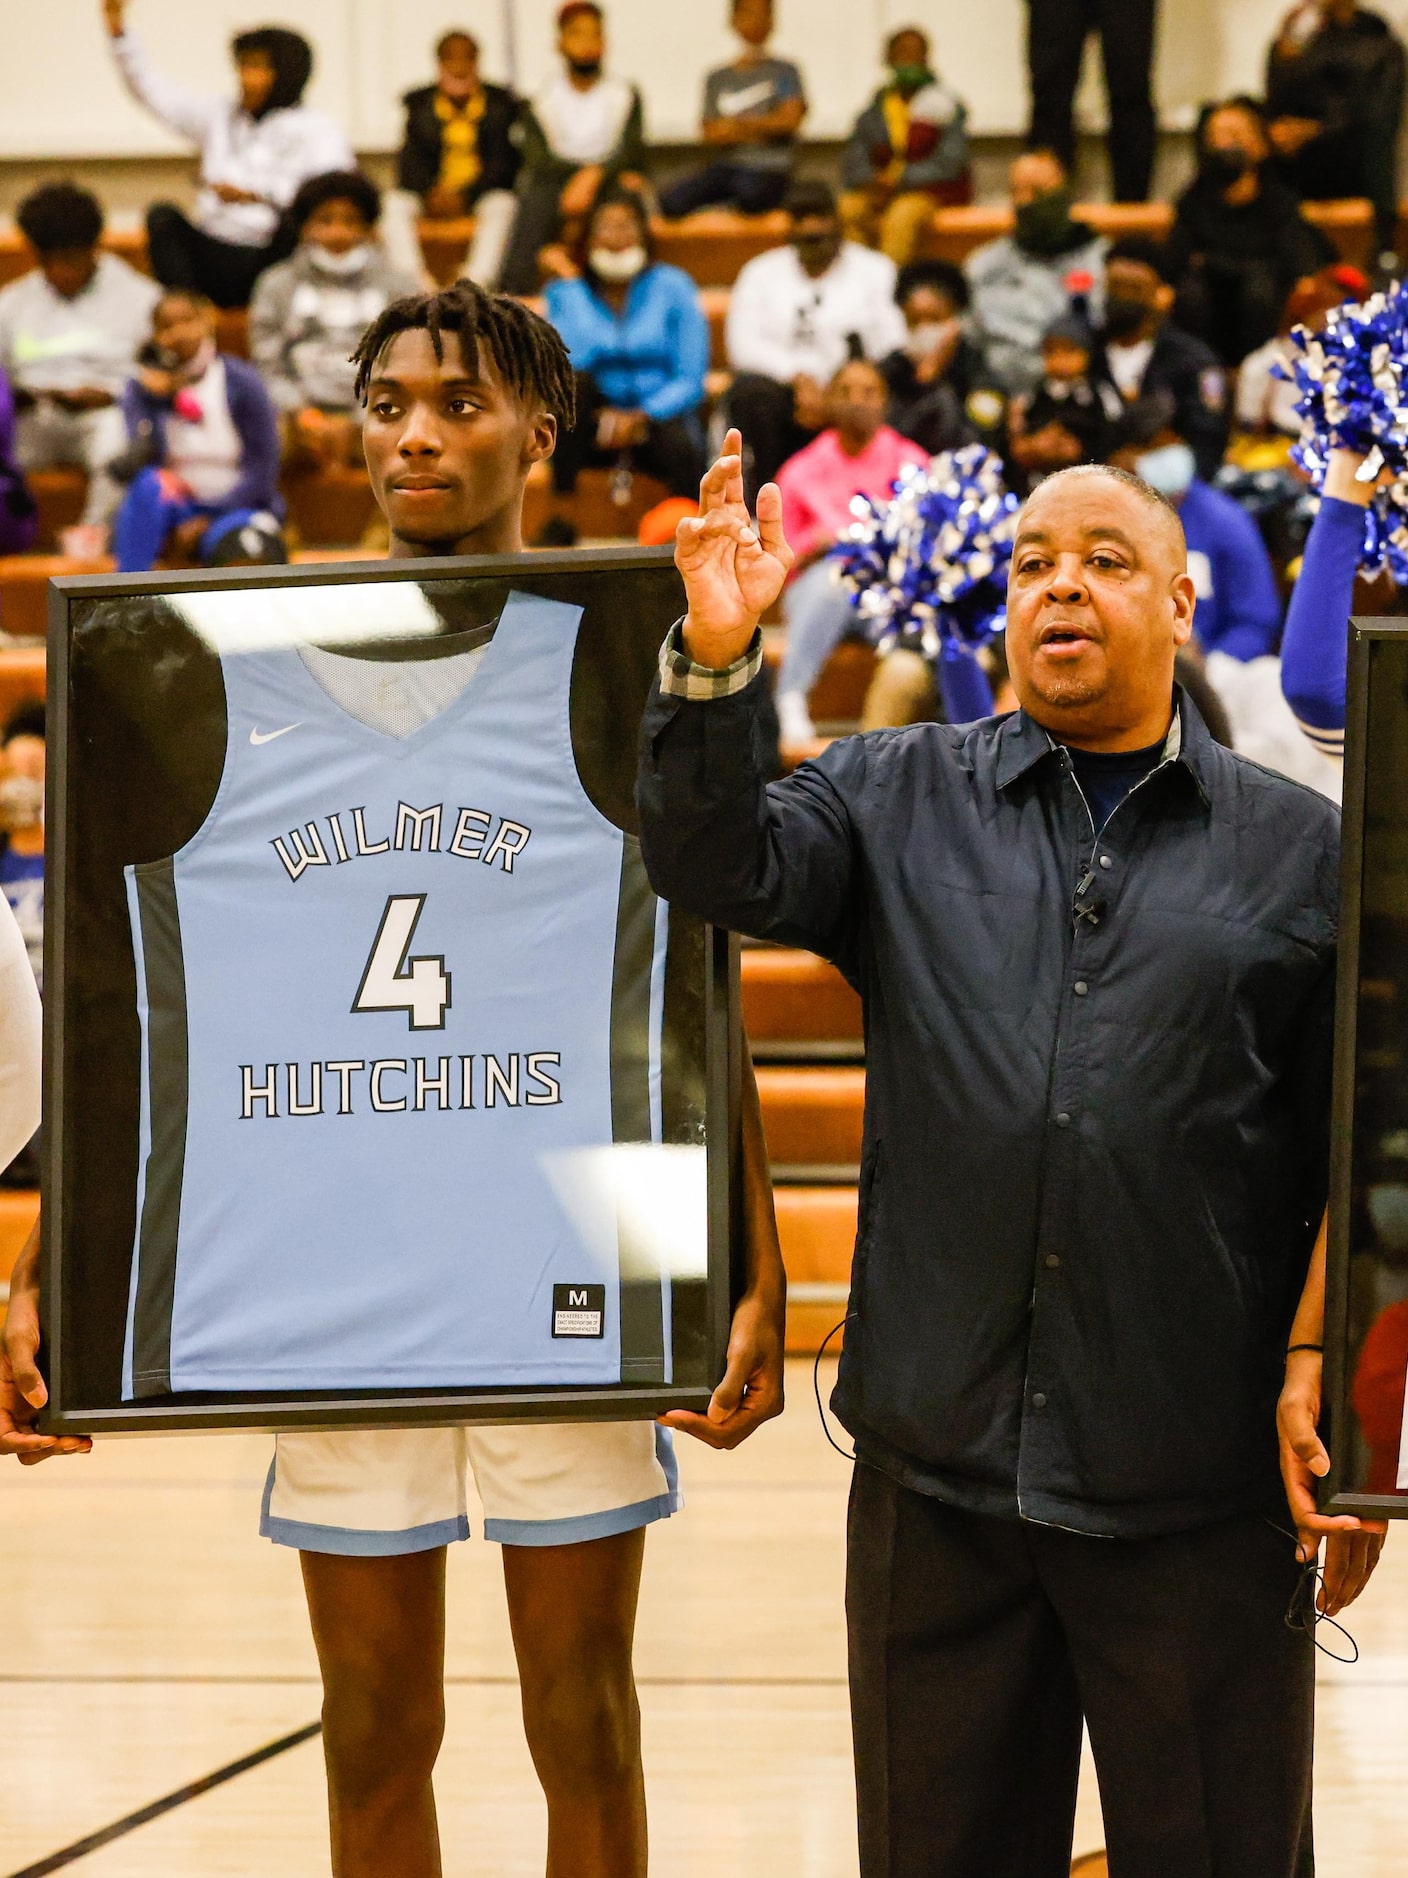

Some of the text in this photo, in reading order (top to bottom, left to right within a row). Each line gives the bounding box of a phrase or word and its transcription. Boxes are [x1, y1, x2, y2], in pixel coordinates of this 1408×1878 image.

[268, 800, 532, 883] WILMER
[349, 893, 452, 1032] 4
[238, 1051, 563, 1119] HUTCHINS
[569, 1290, 588, 1306] M
